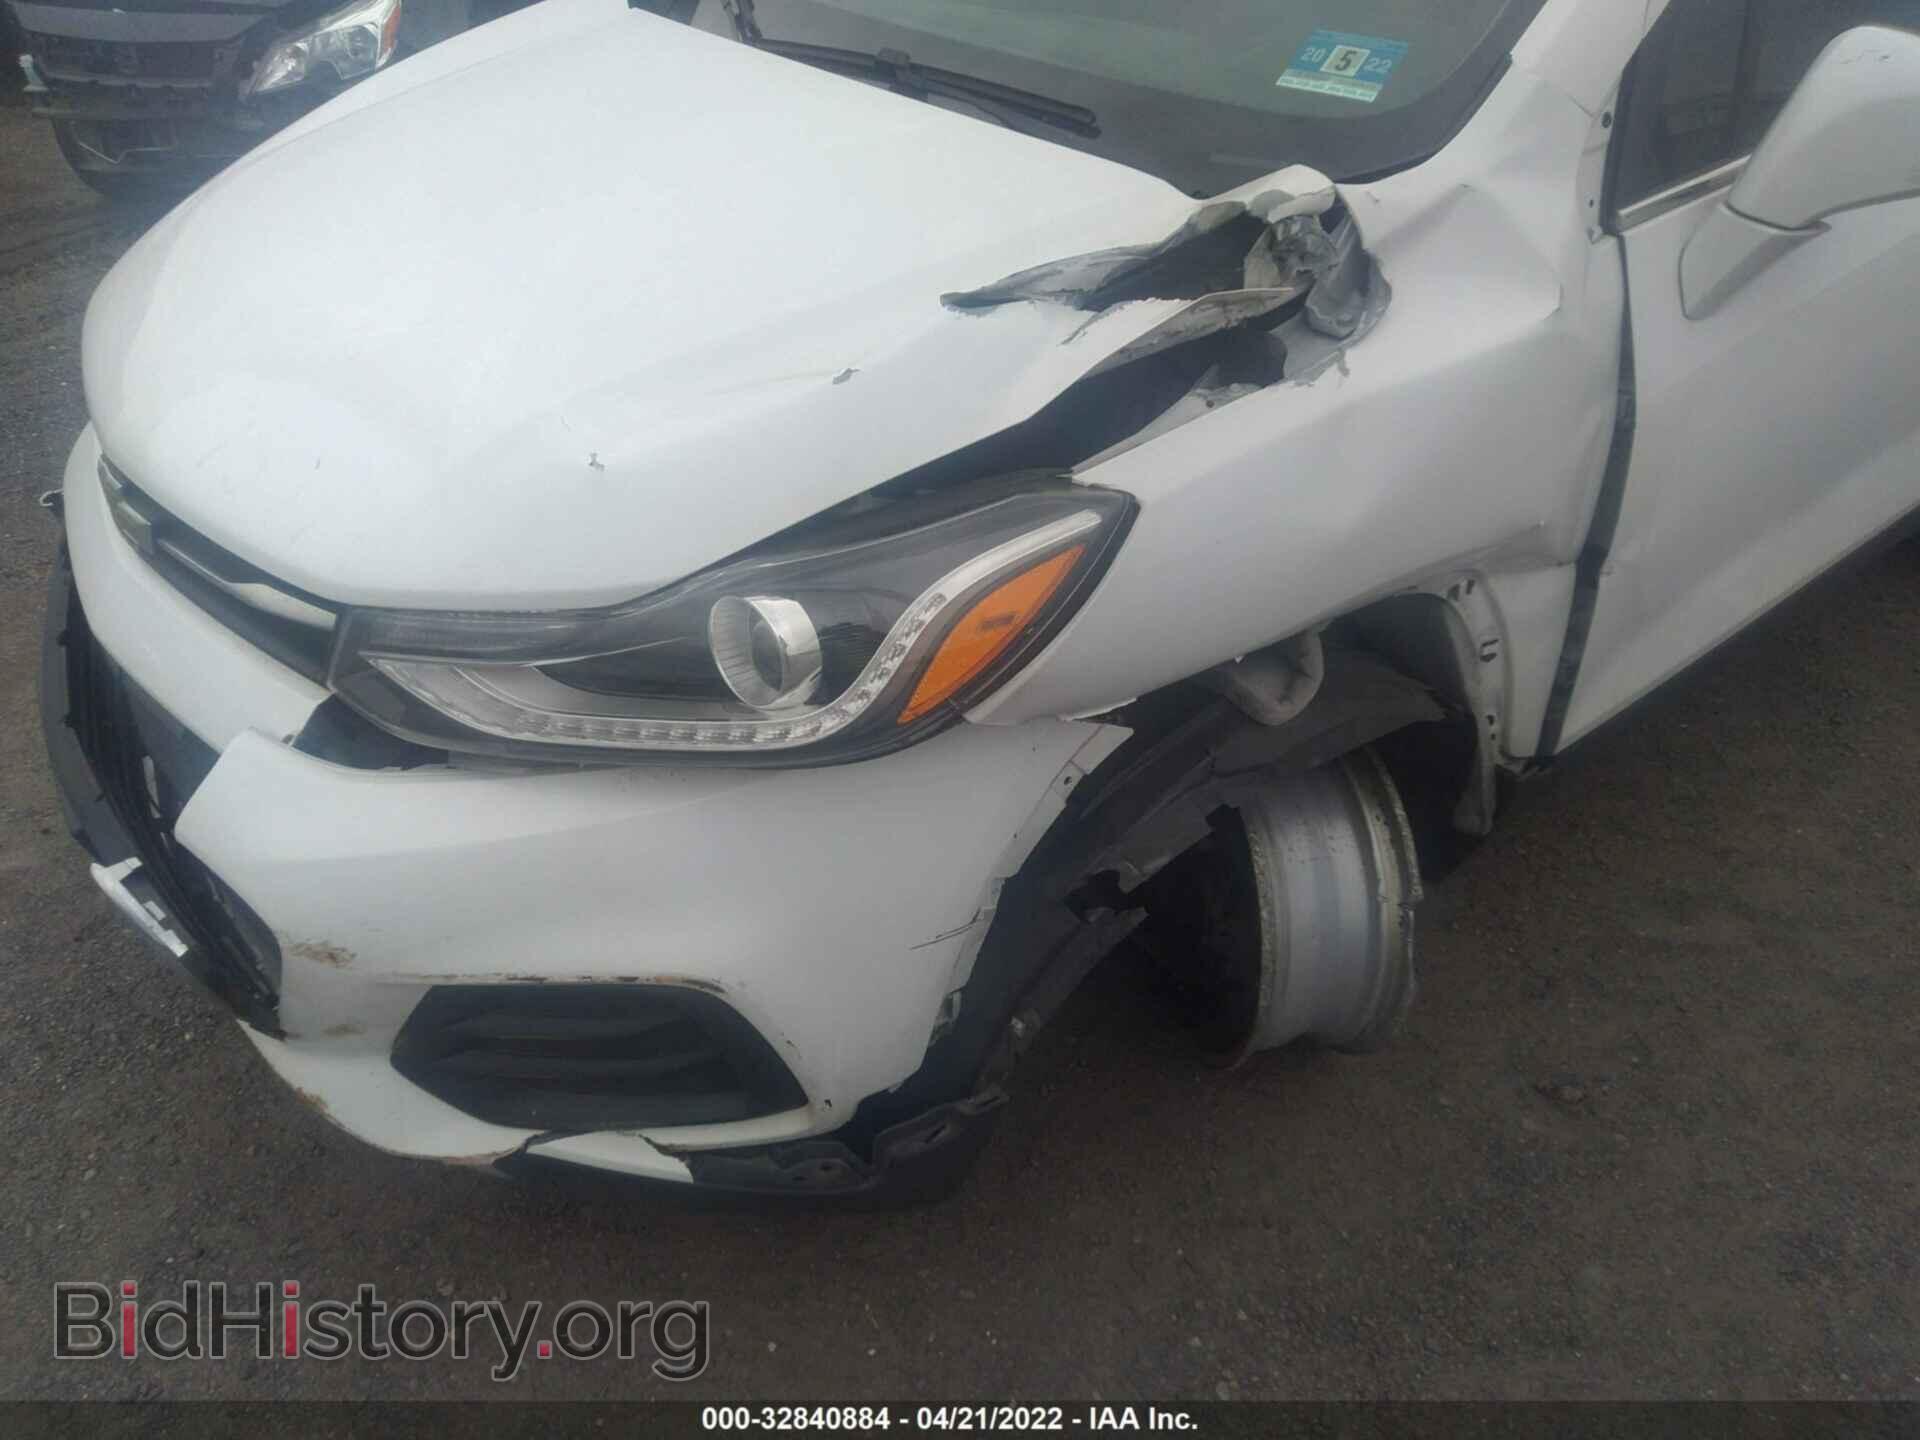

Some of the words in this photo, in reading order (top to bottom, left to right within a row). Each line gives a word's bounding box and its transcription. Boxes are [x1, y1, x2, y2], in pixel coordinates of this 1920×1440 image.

[1301, 48, 1326, 63] 20
[1335, 50, 1357, 71] 5
[1363, 57, 1392, 73] 22
